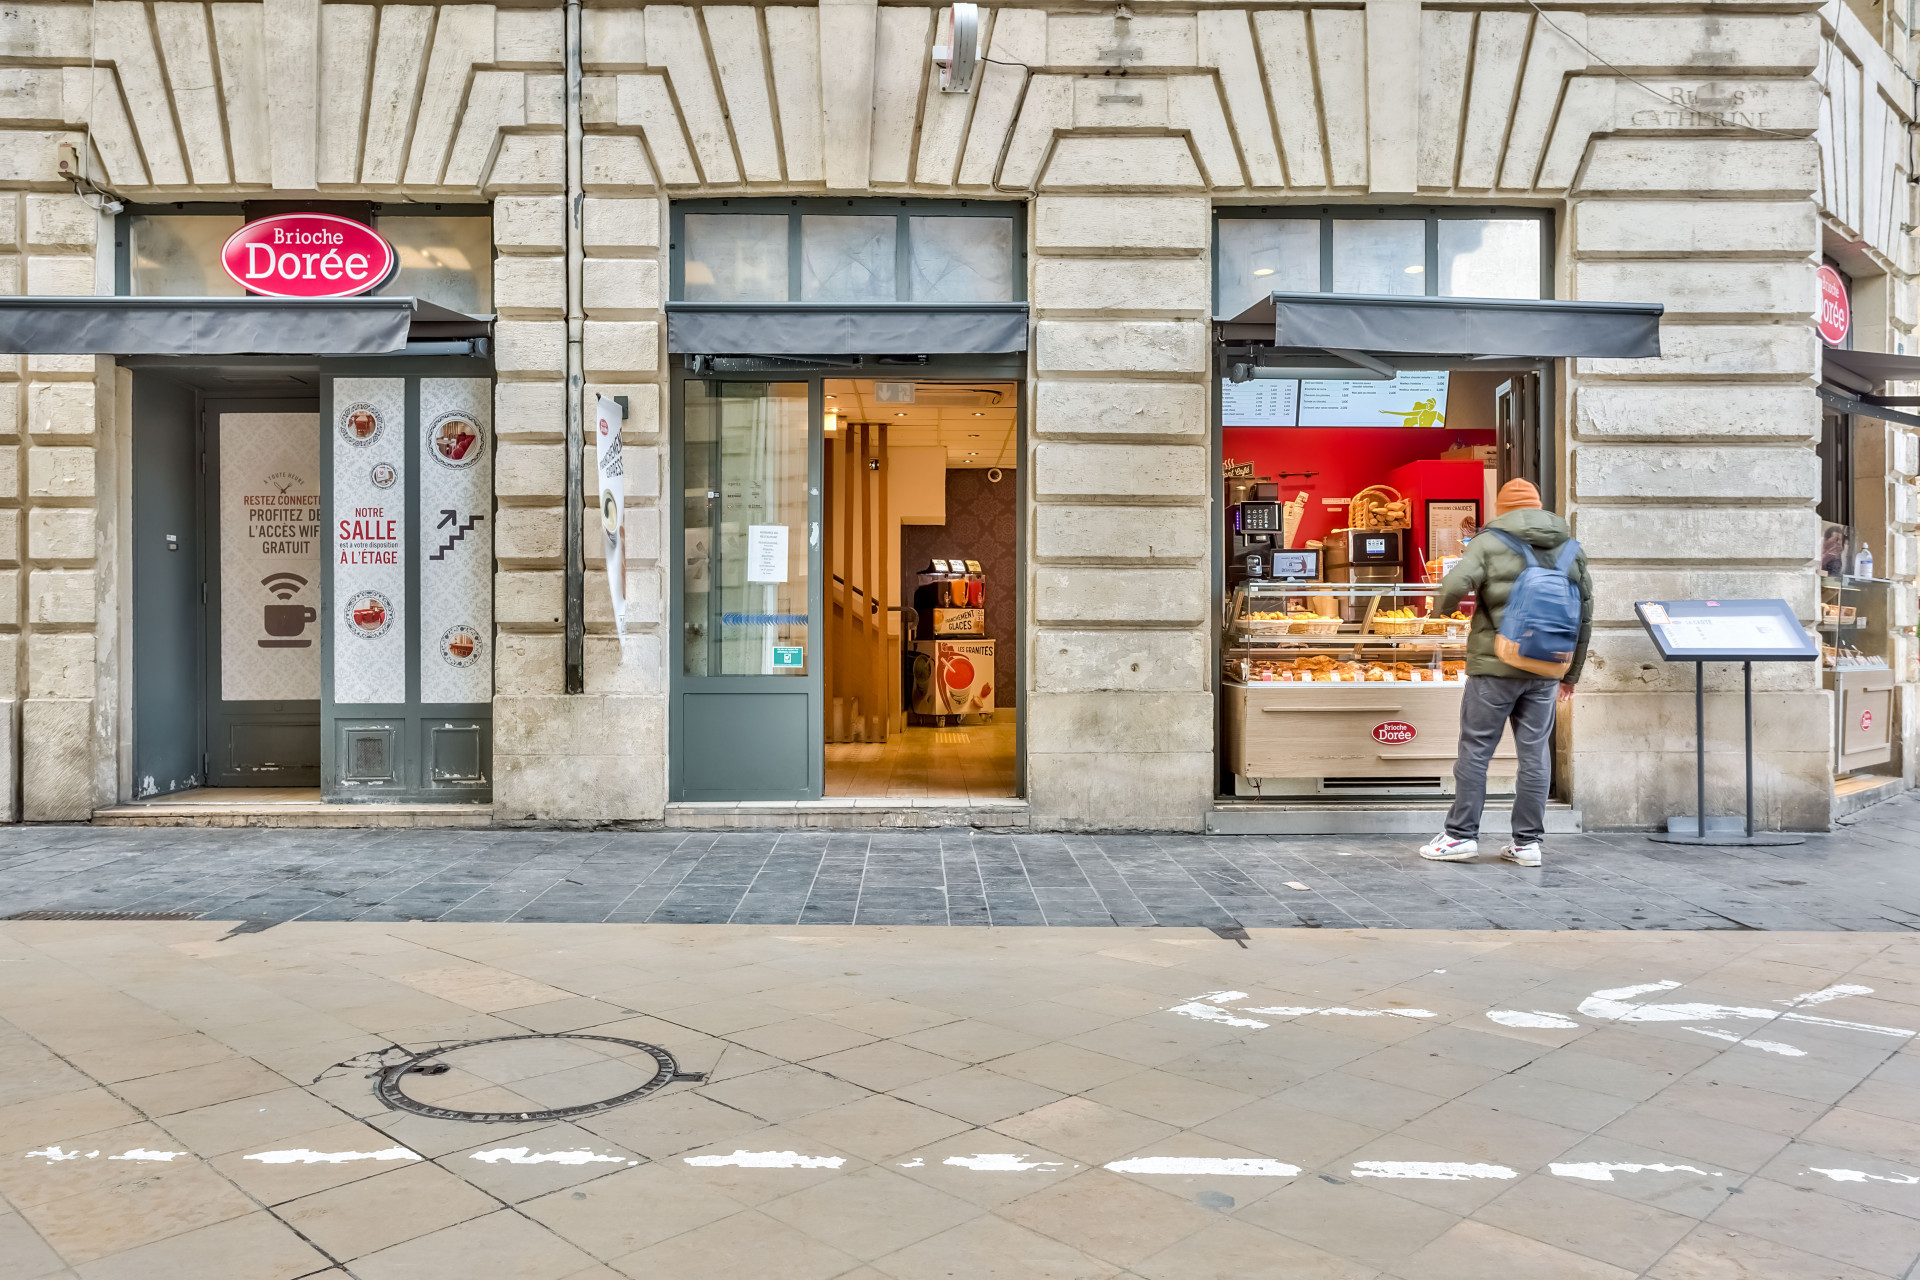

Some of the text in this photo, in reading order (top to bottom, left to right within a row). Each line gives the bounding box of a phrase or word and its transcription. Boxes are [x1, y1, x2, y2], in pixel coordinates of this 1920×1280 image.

[1631, 110, 1771, 128] CATHERINE
[273, 228, 344, 245] Brioche
[245, 242, 369, 280] Dorée
[1823, 298, 1845, 331] orée
[268, 472, 286, 481] TOUTE
[243, 495, 276, 505] RESTEZ
[249, 509, 303, 522] PROFITEZ
[355, 507, 384, 518] NOTRE
[248, 522, 320, 538] L'ACCÈS WIF
[339, 520, 397, 541] SALLE
[262, 541, 310, 554] GRATUIT
[369, 541, 399, 550] disposition
[340, 548, 398, 565] À L'ÉTAGE
[1378, 729, 1412, 740] Dorée
